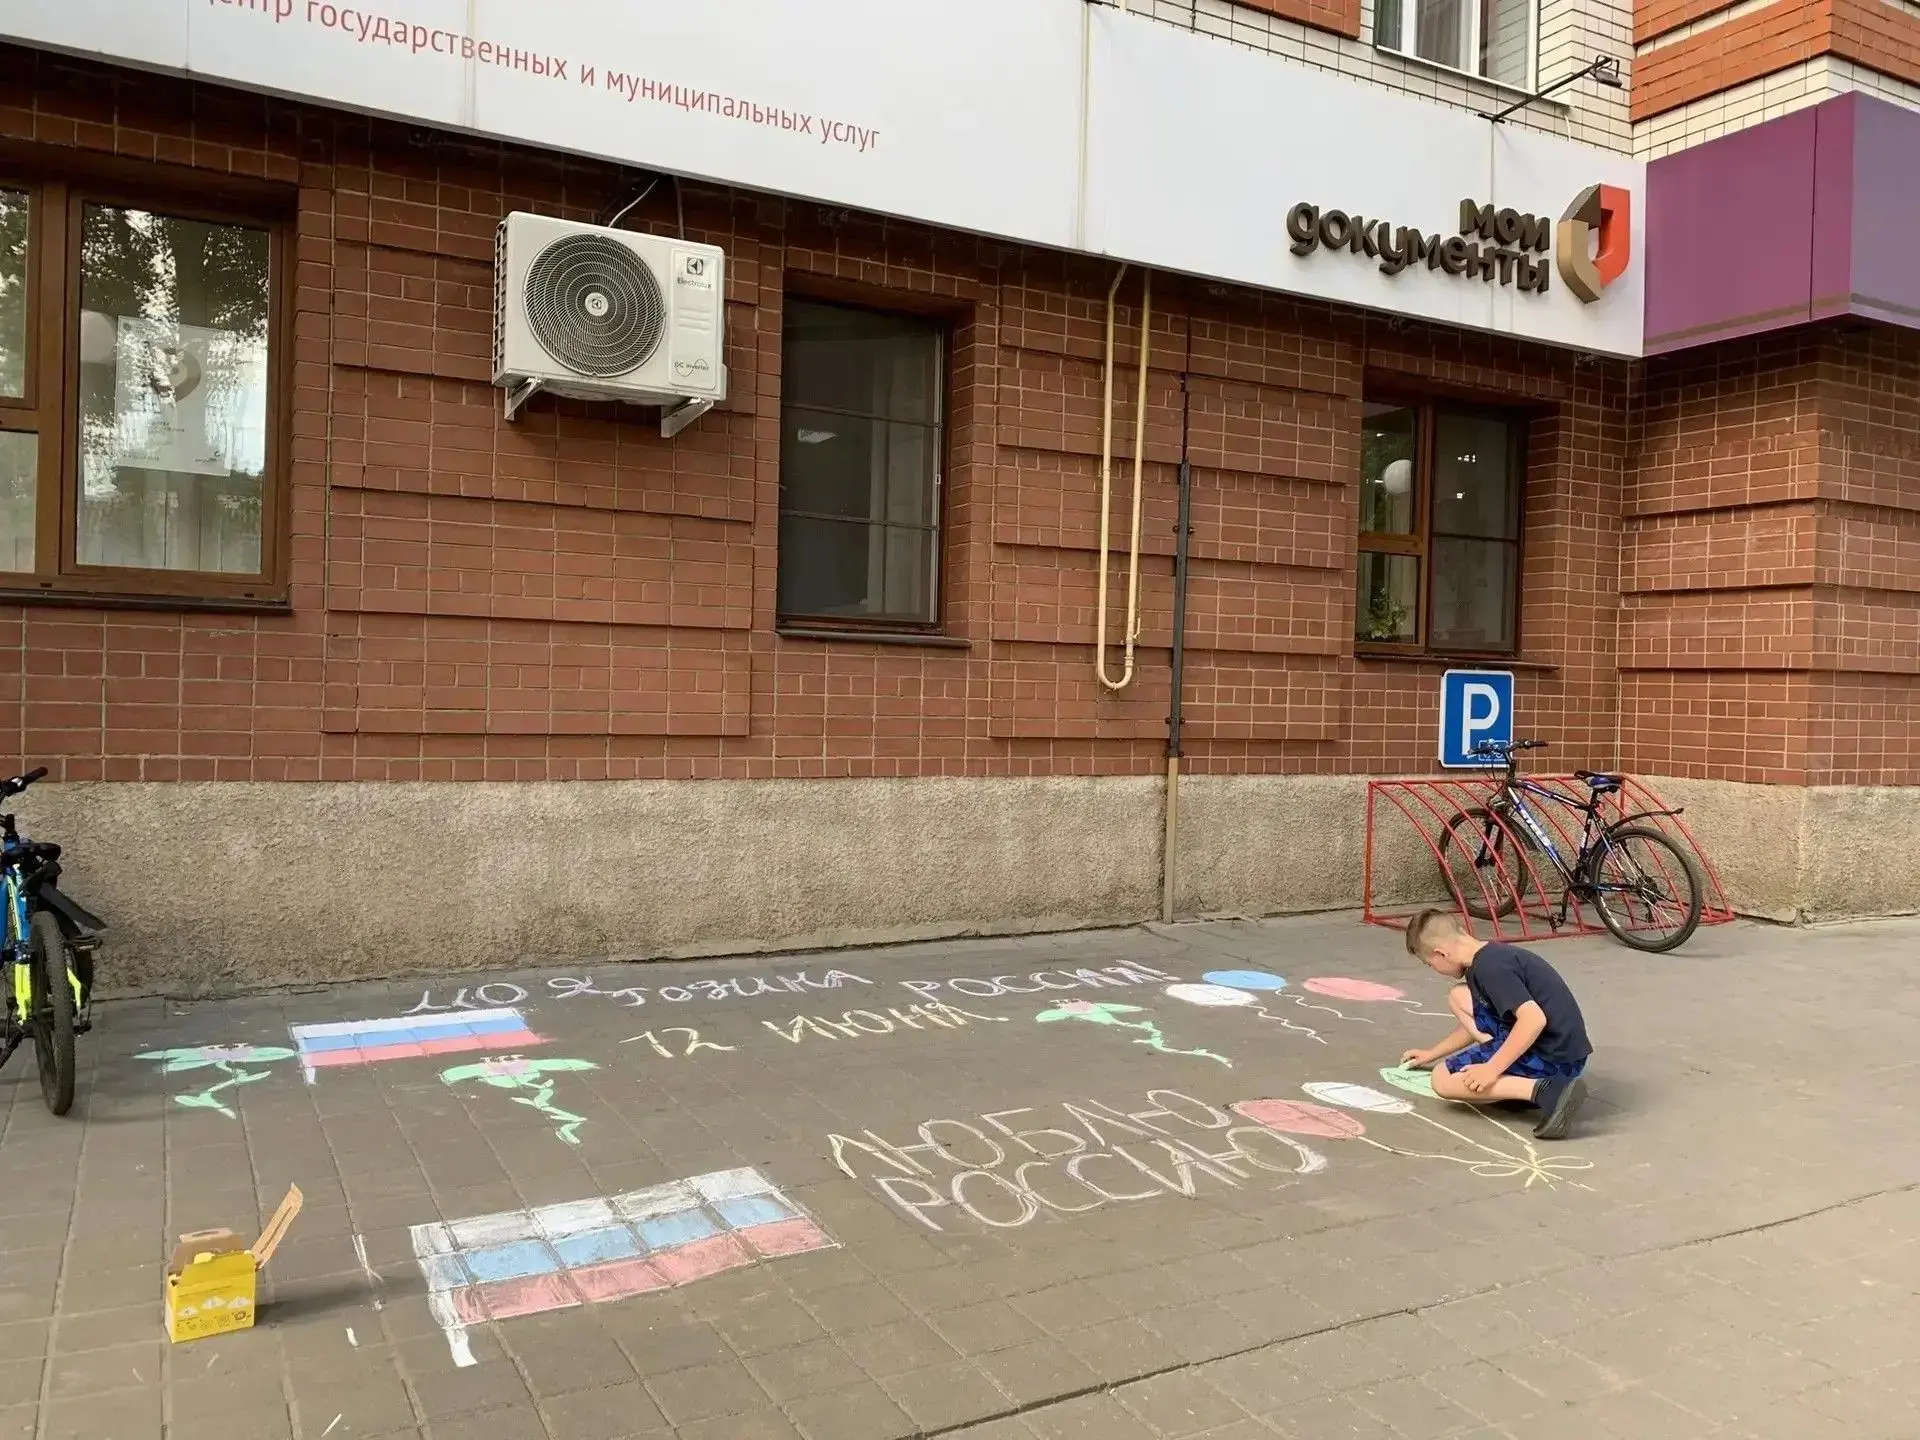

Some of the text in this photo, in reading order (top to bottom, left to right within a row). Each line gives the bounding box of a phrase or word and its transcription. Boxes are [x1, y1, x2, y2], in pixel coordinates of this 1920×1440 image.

[307, 1, 568, 81] государственных
[580, 64, 595, 87] и
[606, 70, 812, 135] муниципальных
[819, 118, 881, 153] услуг
[1286, 201, 1551, 293] документы
[1459, 198, 1551, 251] мои
[1462, 683, 1500, 756] P
[619, 1027, 742, 1059] 12
[827, 1089, 1233, 1179] ЛЮБЛЮ
[872, 1126, 1329, 1231] РОССИЮ
